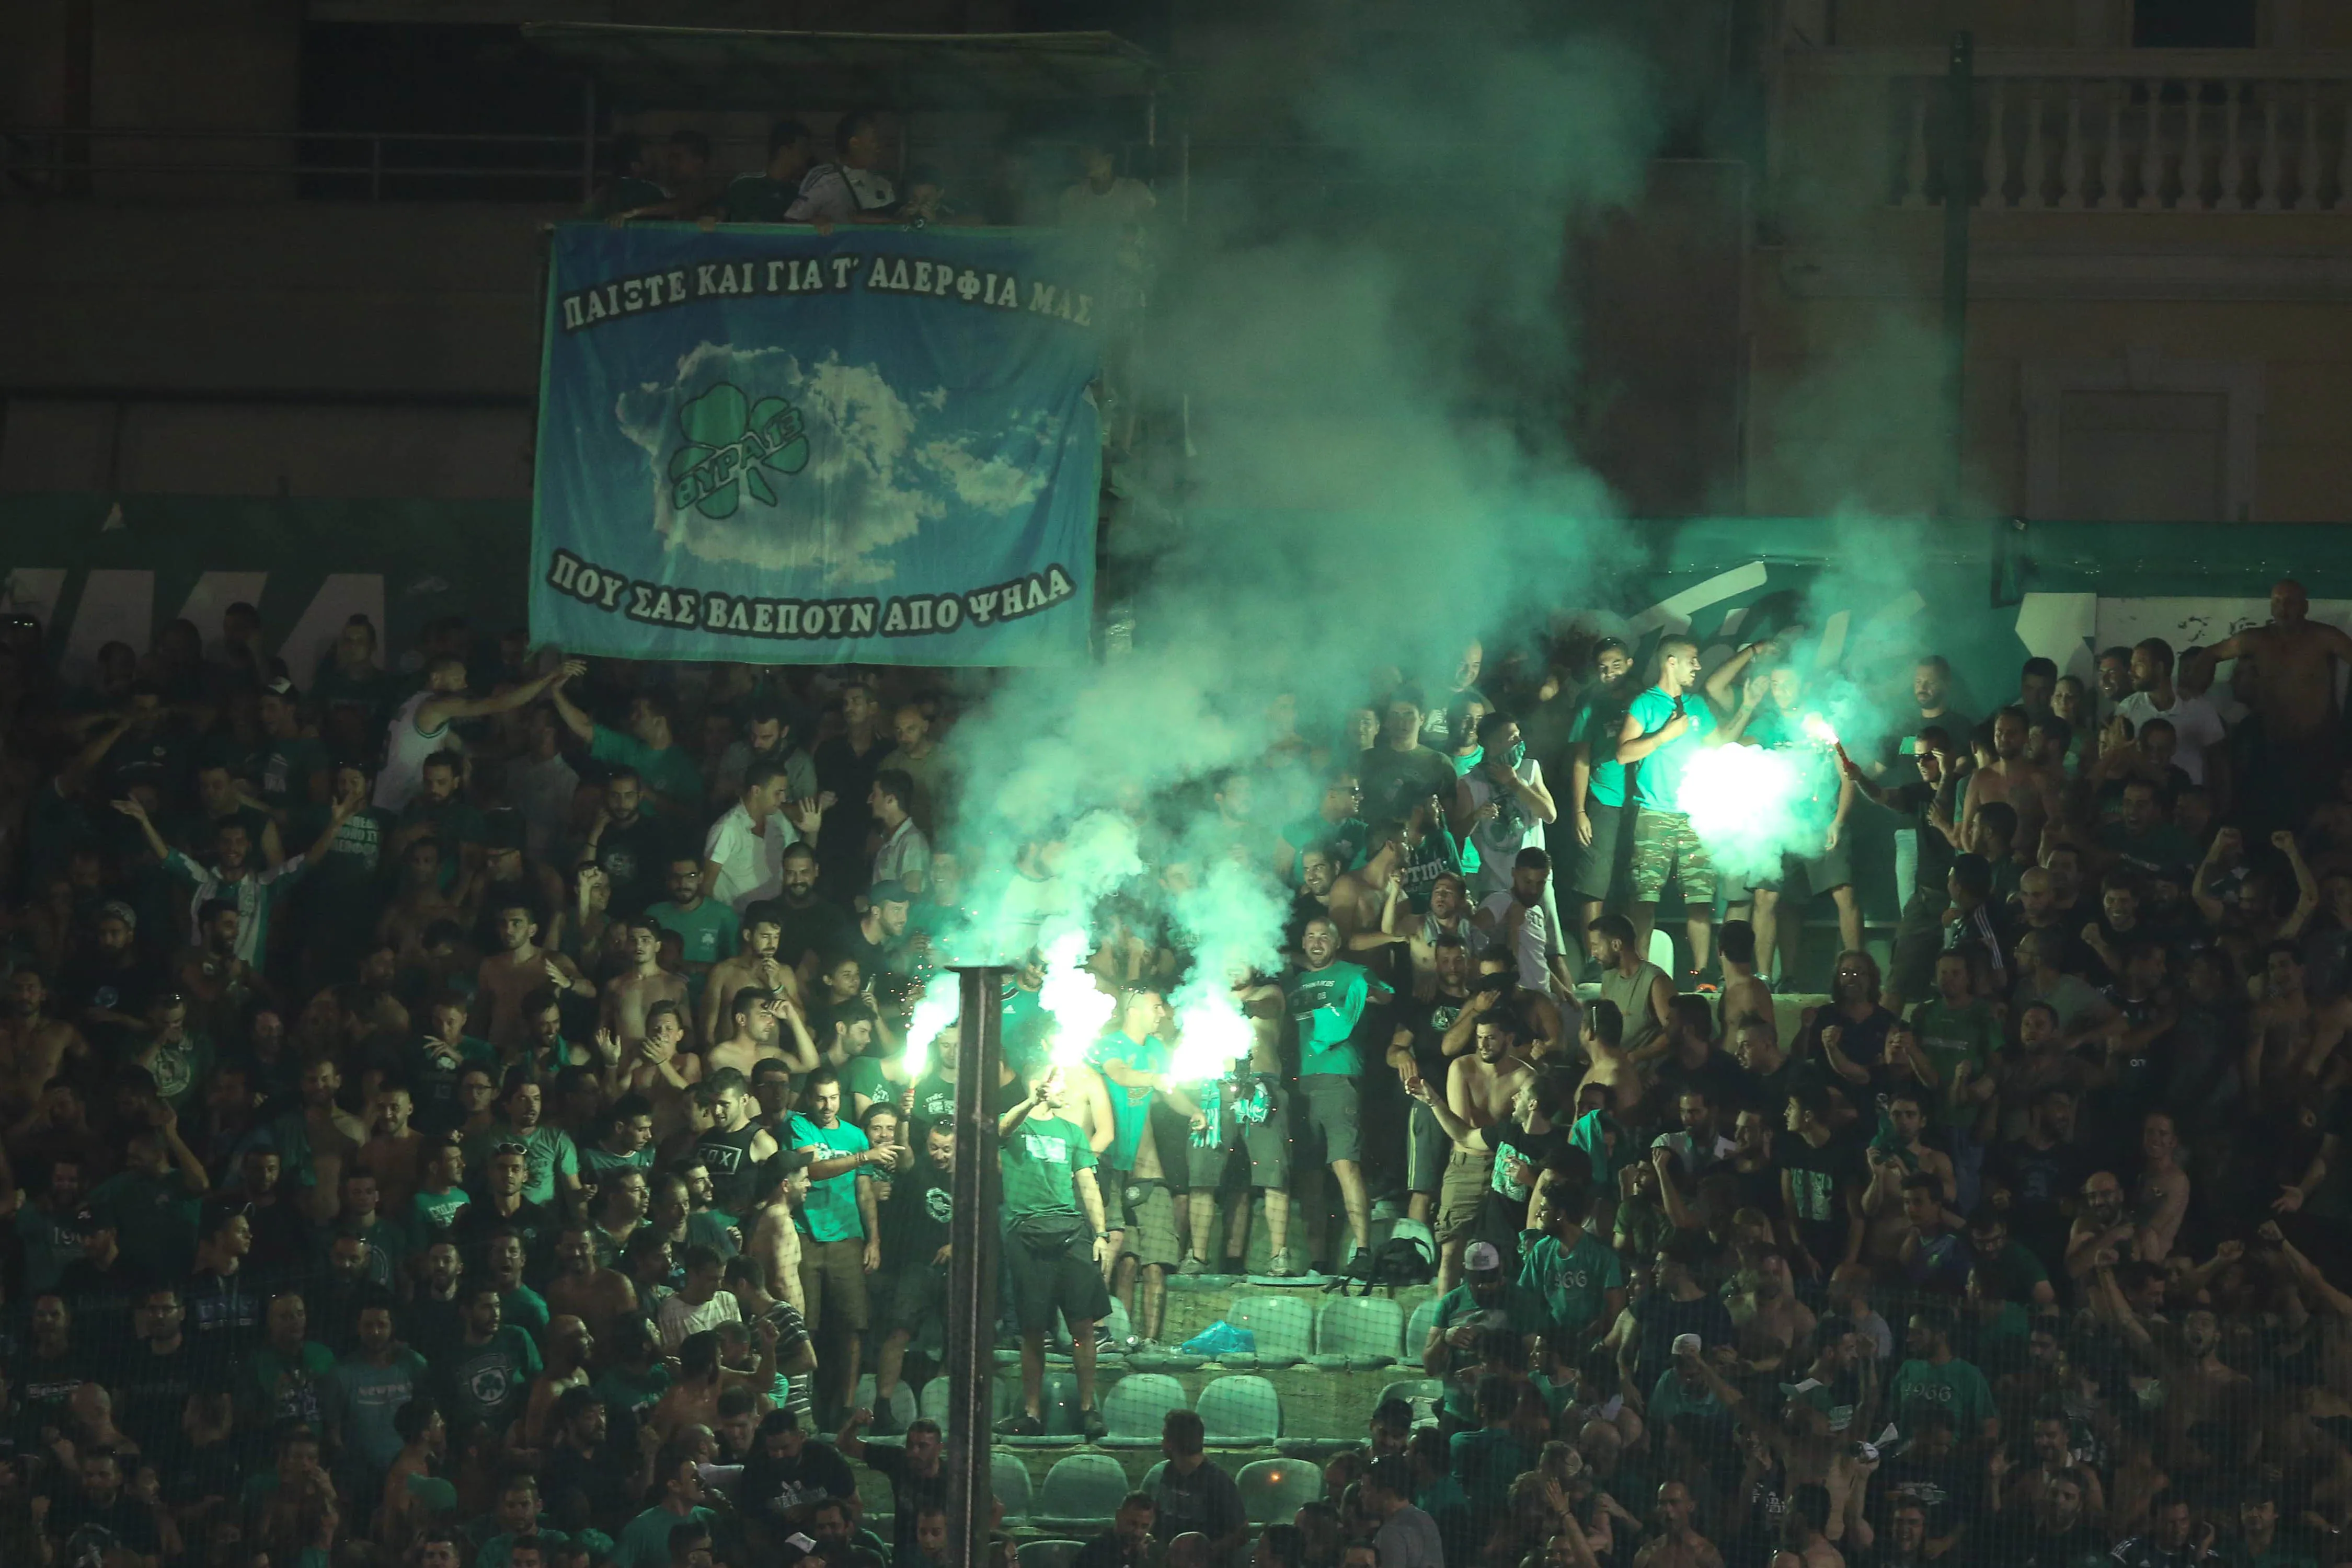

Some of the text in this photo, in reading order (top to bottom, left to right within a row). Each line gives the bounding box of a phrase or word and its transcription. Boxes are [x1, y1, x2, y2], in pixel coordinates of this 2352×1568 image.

[563, 270, 686, 330] ΠΑΙΞΤΕ
[698, 263, 753, 296] ΚΑΙ
[766, 260, 823, 291] ΓΙΑ
[868, 258, 1017, 308] ΑΔΕΡΦΙΑ
[1029, 282, 1093, 327] ΜΑΣ
[672, 407, 804, 510] ΘΥΡΑ 13
[552, 555, 1071, 634] ΠΟΥ ΣΑΣ ΒΛΕΠΟΥΝ ΑΠΟ ΨΗΛΑ
[697, 1148, 732, 1167] FOX
[1905, 1382, 1953, 1402] 1966
